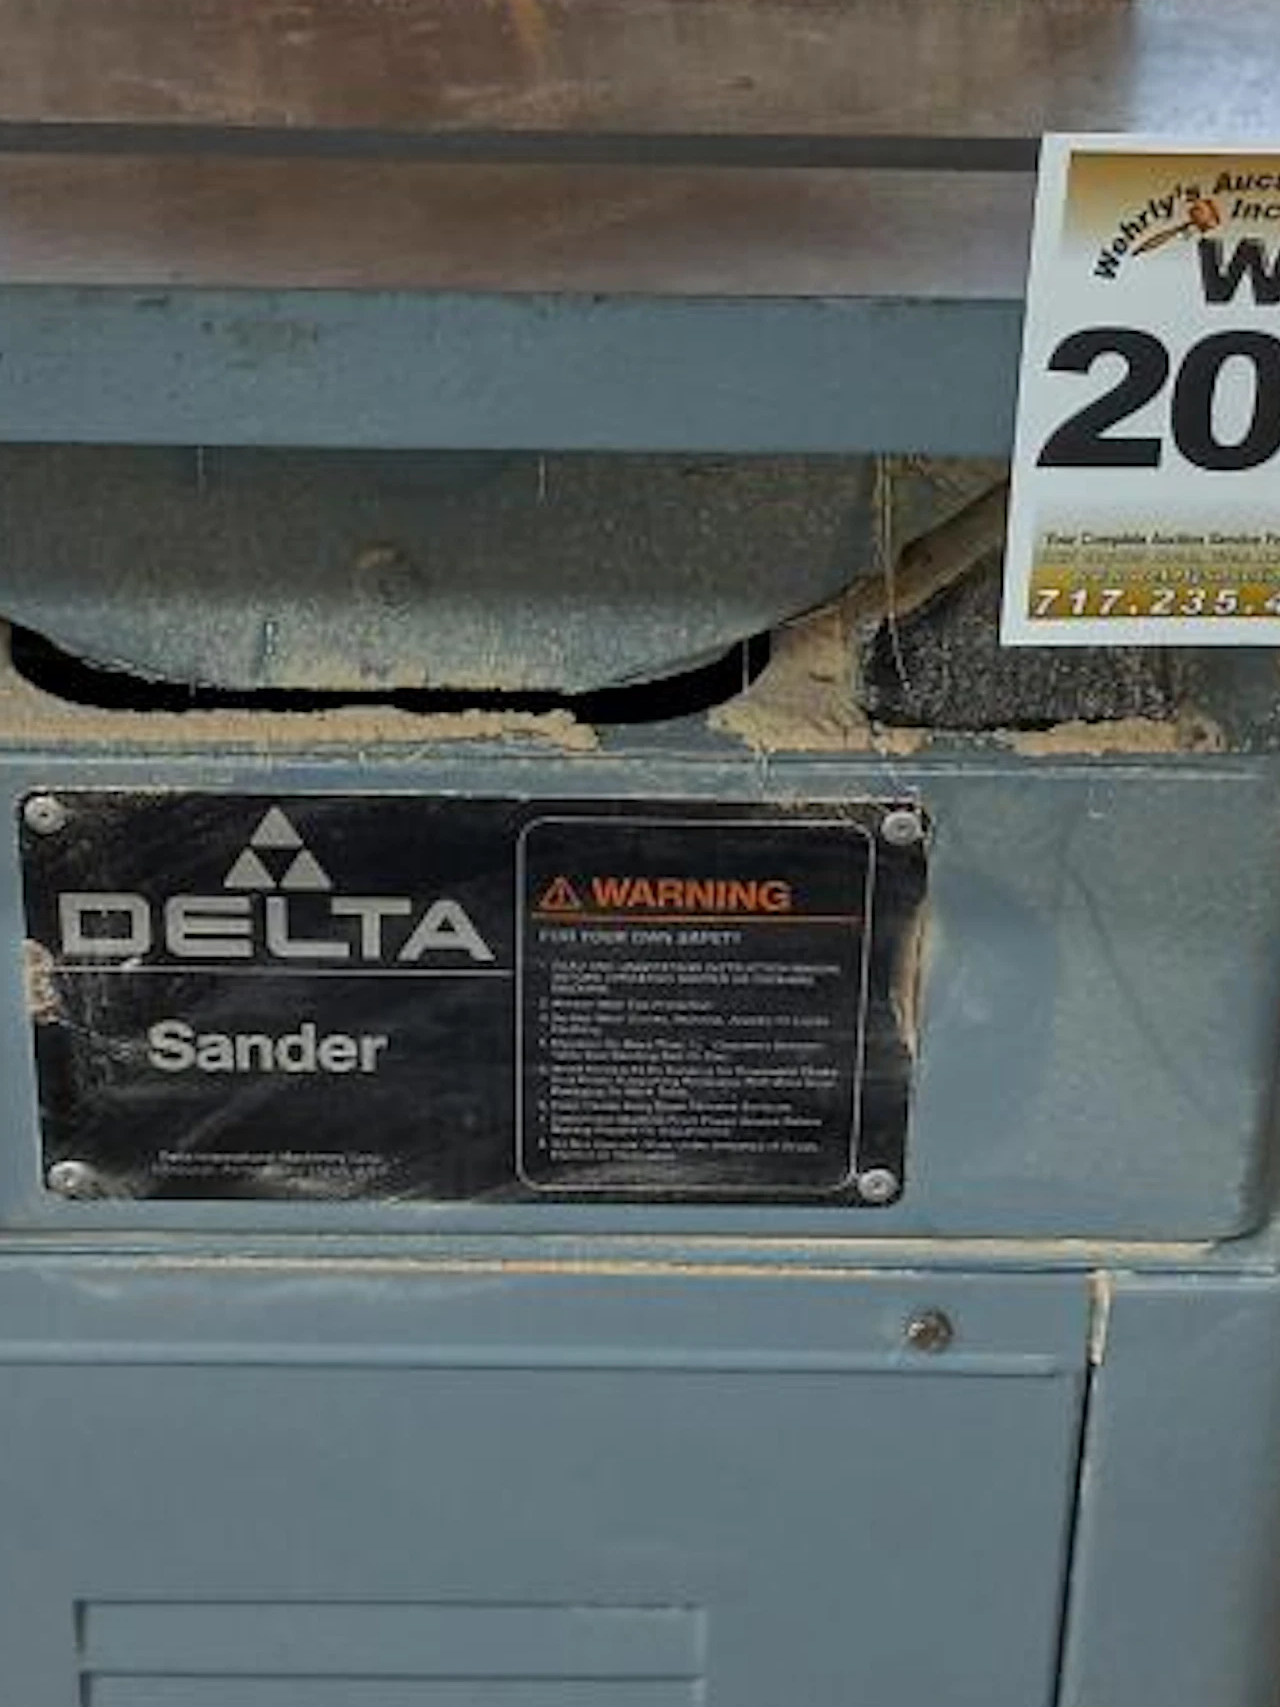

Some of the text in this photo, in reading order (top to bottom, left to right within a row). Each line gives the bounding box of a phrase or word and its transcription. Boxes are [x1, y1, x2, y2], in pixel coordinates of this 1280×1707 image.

[592, 877, 793, 911] WARNING
[57, 892, 496, 962] DELTA
[147, 1018, 390, 1074] Sander
